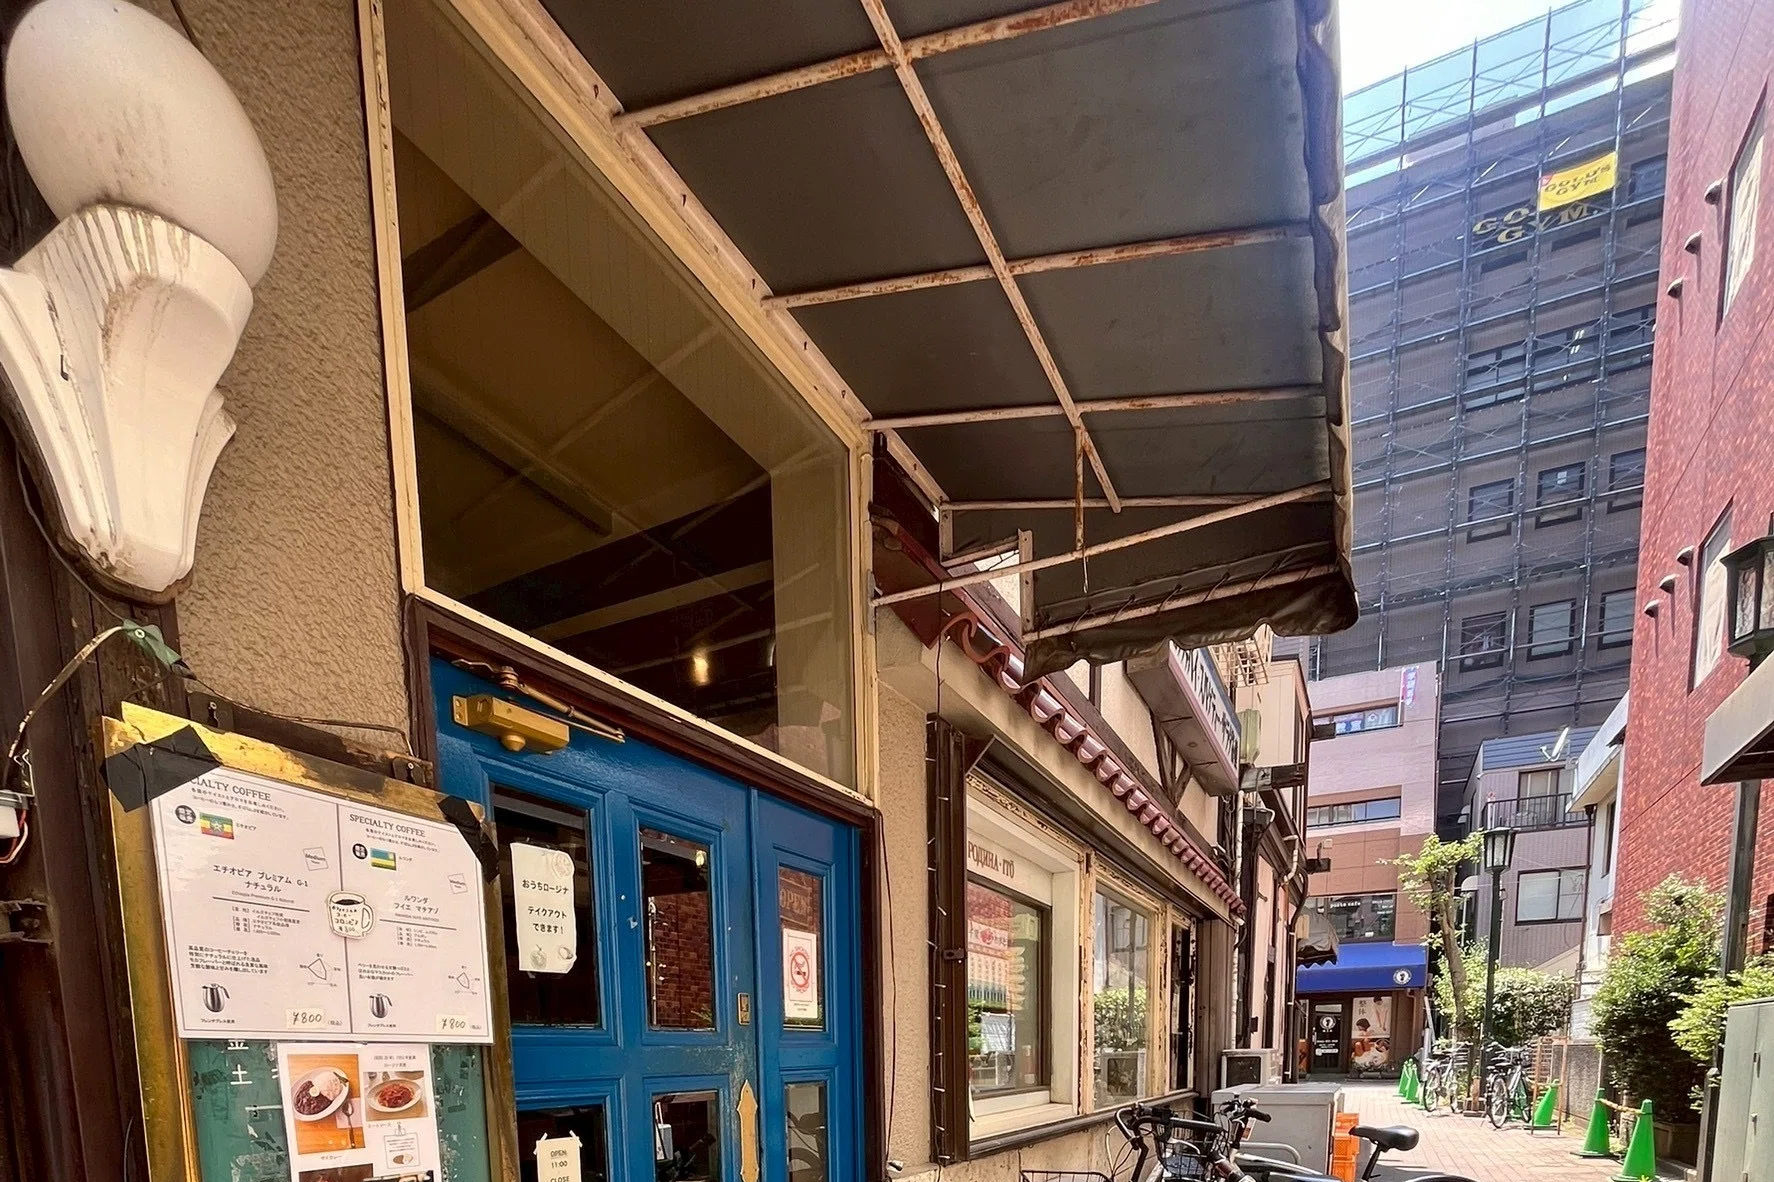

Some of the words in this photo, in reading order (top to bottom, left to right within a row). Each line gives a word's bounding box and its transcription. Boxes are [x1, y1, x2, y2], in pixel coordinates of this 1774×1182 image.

[191, 778, 229, 792] CIALTY
[232, 785, 272, 801] COFFEE
[349, 813, 395, 831] SPECIALTY
[395, 823, 426, 838] COFFEE
[213, 865, 252, 877] エチオピア
[257, 871, 292, 884] プレミアム
[244, 881, 282, 893] ナチュラル
[522, 879, 569, 895] おうちロージナ
[404, 895, 429, 904] ルワンダ
[527, 906, 567, 919] テイクアウト
[292, 1011, 322, 1026] ¥800
[441, 1018, 466, 1030] ¥800
[230, 1063, 253, 1085] 土
[550, 1149, 567, 1158] OPEN
[551, 1160, 568, 1169] 11:00
